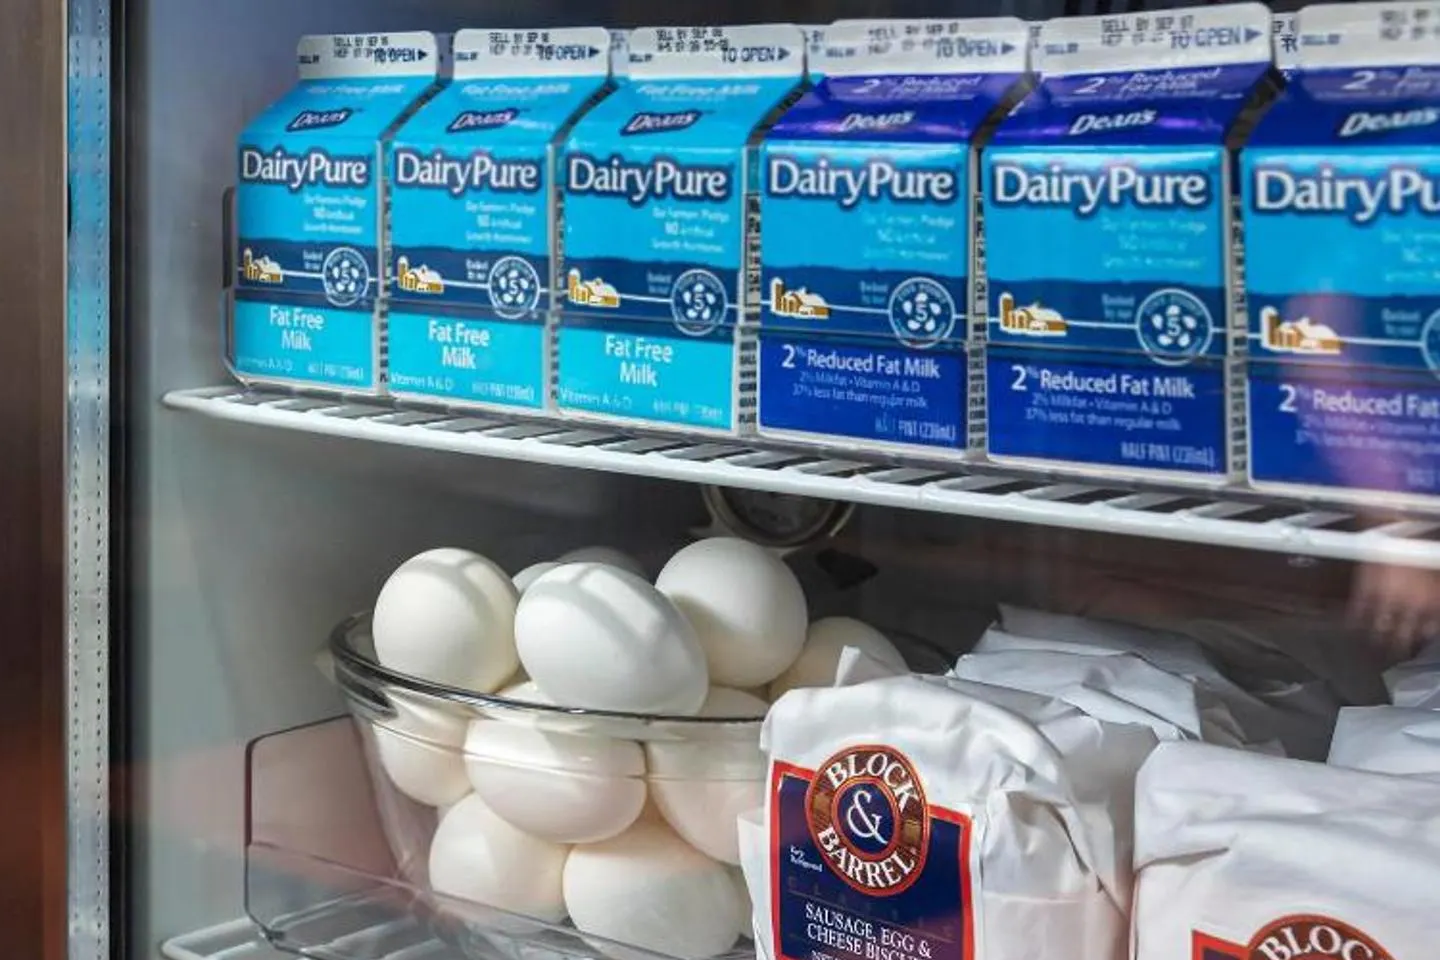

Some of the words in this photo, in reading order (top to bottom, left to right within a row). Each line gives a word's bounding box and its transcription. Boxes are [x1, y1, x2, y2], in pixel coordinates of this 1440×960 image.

[958, 38, 998, 59] OPEN
[1194, 27, 1241, 48] OPEN
[388, 49, 416, 63] OPEN
[556, 46, 586, 61] OPEN
[722, 48, 737, 63] TO
[742, 47, 775, 62] OPEN
[242, 149, 368, 189] DairyPure
[396, 151, 538, 194] DairyPure
[569, 157, 728, 202] DairyPure
[770, 158, 954, 206] DairyPure
[994, 164, 1208, 215] DairyPure
[1255, 167, 1440, 223] DairyPu
[269, 305, 292, 327] Fat
[293, 307, 325, 331] Free
[428, 319, 452, 342] Fat
[455, 322, 491, 347] Free
[281, 329, 312, 351] Milk
[605, 334, 631, 359] Fat
[635, 337, 673, 364] Free
[442, 344, 477, 370] Milk
[807, 348, 874, 375] Reduced
[876, 353, 901, 376] Fat
[903, 356, 941, 379] Milk
[620, 361, 658, 387] Milk
[1040, 369, 1117, 394] Reduced
[1120, 373, 1150, 396] Fat
[1152, 376, 1196, 399] Milk
[1312, 389, 1402, 417] Reduced
[825, 751, 920, 812] BLOCK
[846, 789, 889, 845] &
[817, 822, 916, 889] BARREL
[805, 901, 877, 941] SAUSAGE,
[880, 926, 914, 953] EGG
[919, 939, 933, 960] &
[807, 922, 862, 956] CHEESE
